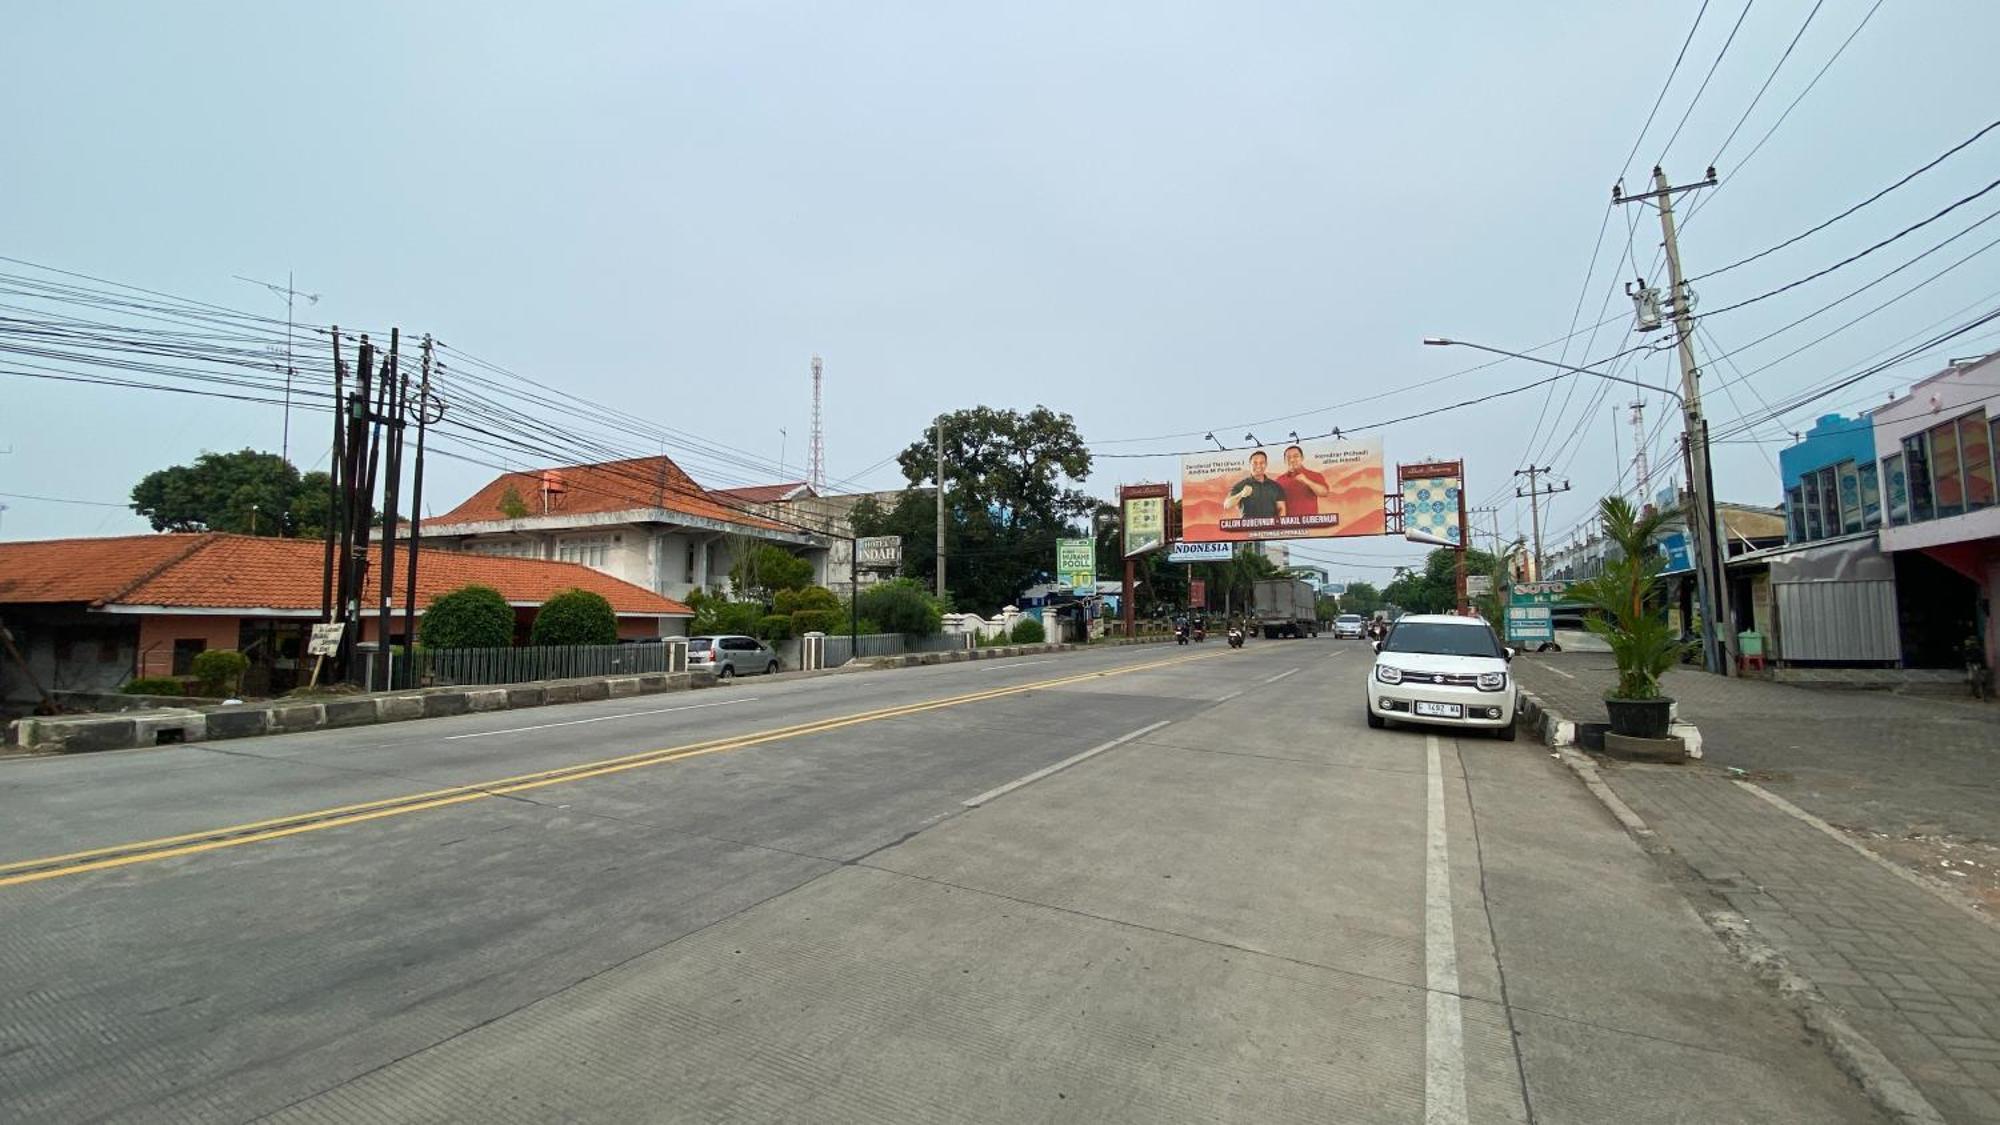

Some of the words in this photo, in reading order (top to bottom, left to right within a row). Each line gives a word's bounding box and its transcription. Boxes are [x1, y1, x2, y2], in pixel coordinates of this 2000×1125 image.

[1220, 519, 1240, 529] CALON
[1241, 517, 1275, 528] GUBERNUR
[1280, 515, 1301, 525] WAKIL
[1302, 513, 1338, 524] GUBERNUR
[859, 547, 896, 561] INDAH
[1175, 543, 1229, 554] NDONESIA
[1514, 582, 1567, 595] SOTO
